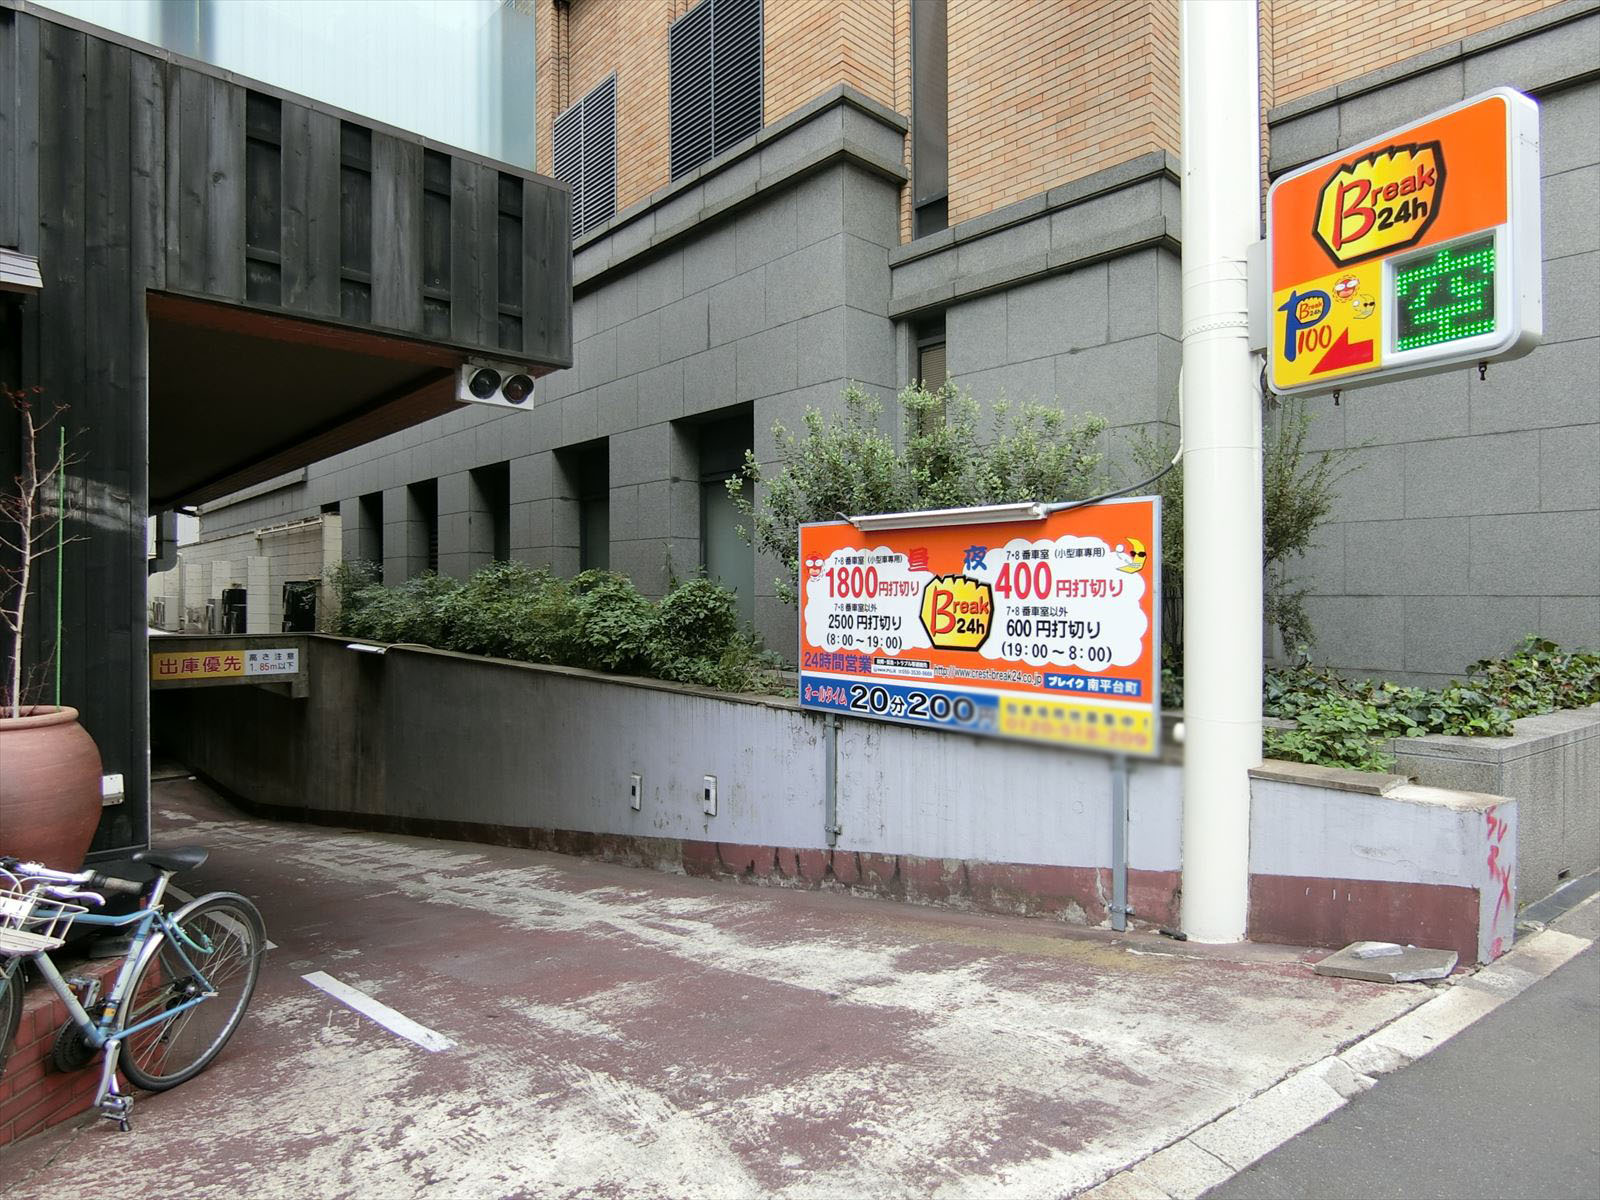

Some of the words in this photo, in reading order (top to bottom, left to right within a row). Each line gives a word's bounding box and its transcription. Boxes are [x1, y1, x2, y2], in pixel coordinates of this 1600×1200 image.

[1332, 164, 1435, 252] Break
[1377, 197, 1428, 231] 24h
[1397, 249, 1497, 352] 空
[1298, 324, 1332, 354] 100
[963, 545, 988, 571] 夜
[930, 586, 989, 637] Break
[957, 617, 985, 634] 24h
[159, 656, 241, 675] 出庫優先
[249, 652, 295, 661] 高さ注意
[804, 651, 872, 673] 24時間営業
[804, 682, 848, 706] オールタイム
[1048, 676, 1085, 689] ブレイク
[1087, 678, 1138, 695] 南平台町
